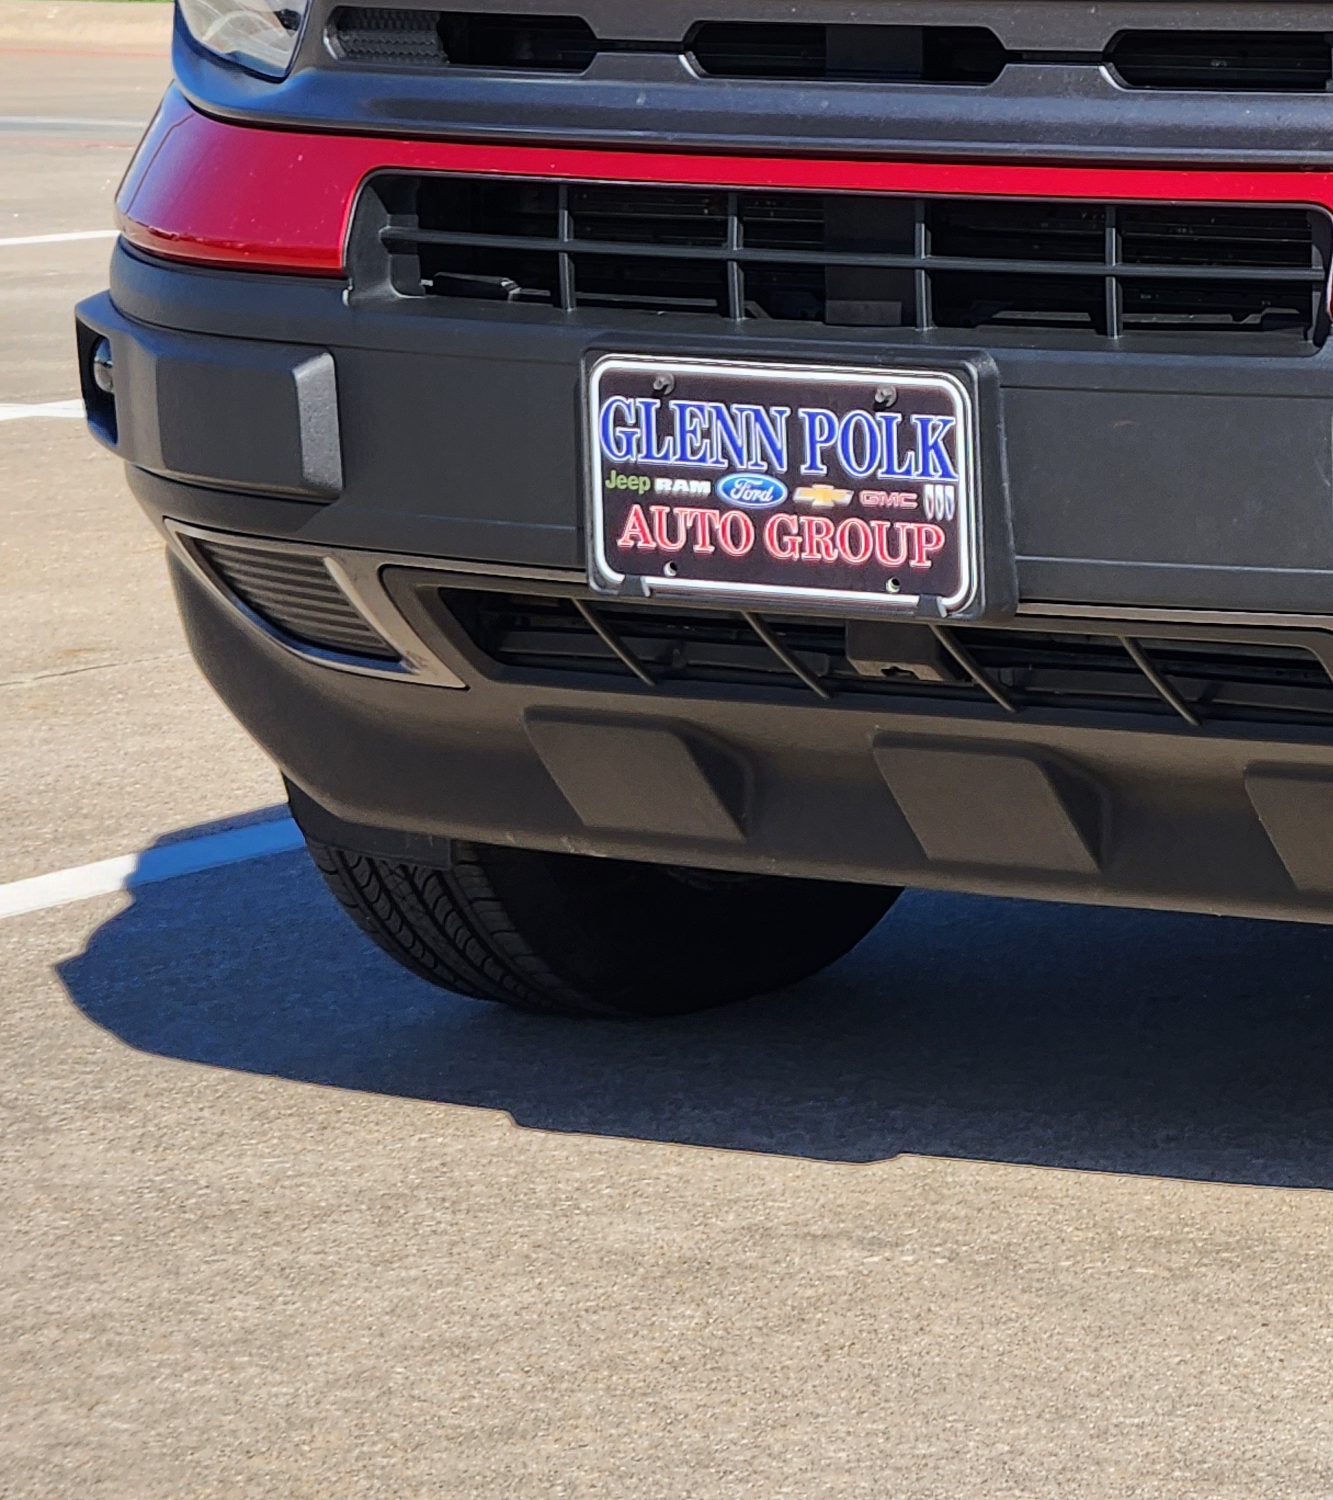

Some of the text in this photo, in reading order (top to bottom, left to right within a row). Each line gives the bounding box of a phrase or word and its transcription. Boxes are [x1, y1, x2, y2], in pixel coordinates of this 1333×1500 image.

[600, 395, 959, 481] GLENN POLK
[605, 469, 918, 509] Jeep RAM Ford GMC
[617, 504, 946, 569] AUTO GROUP
